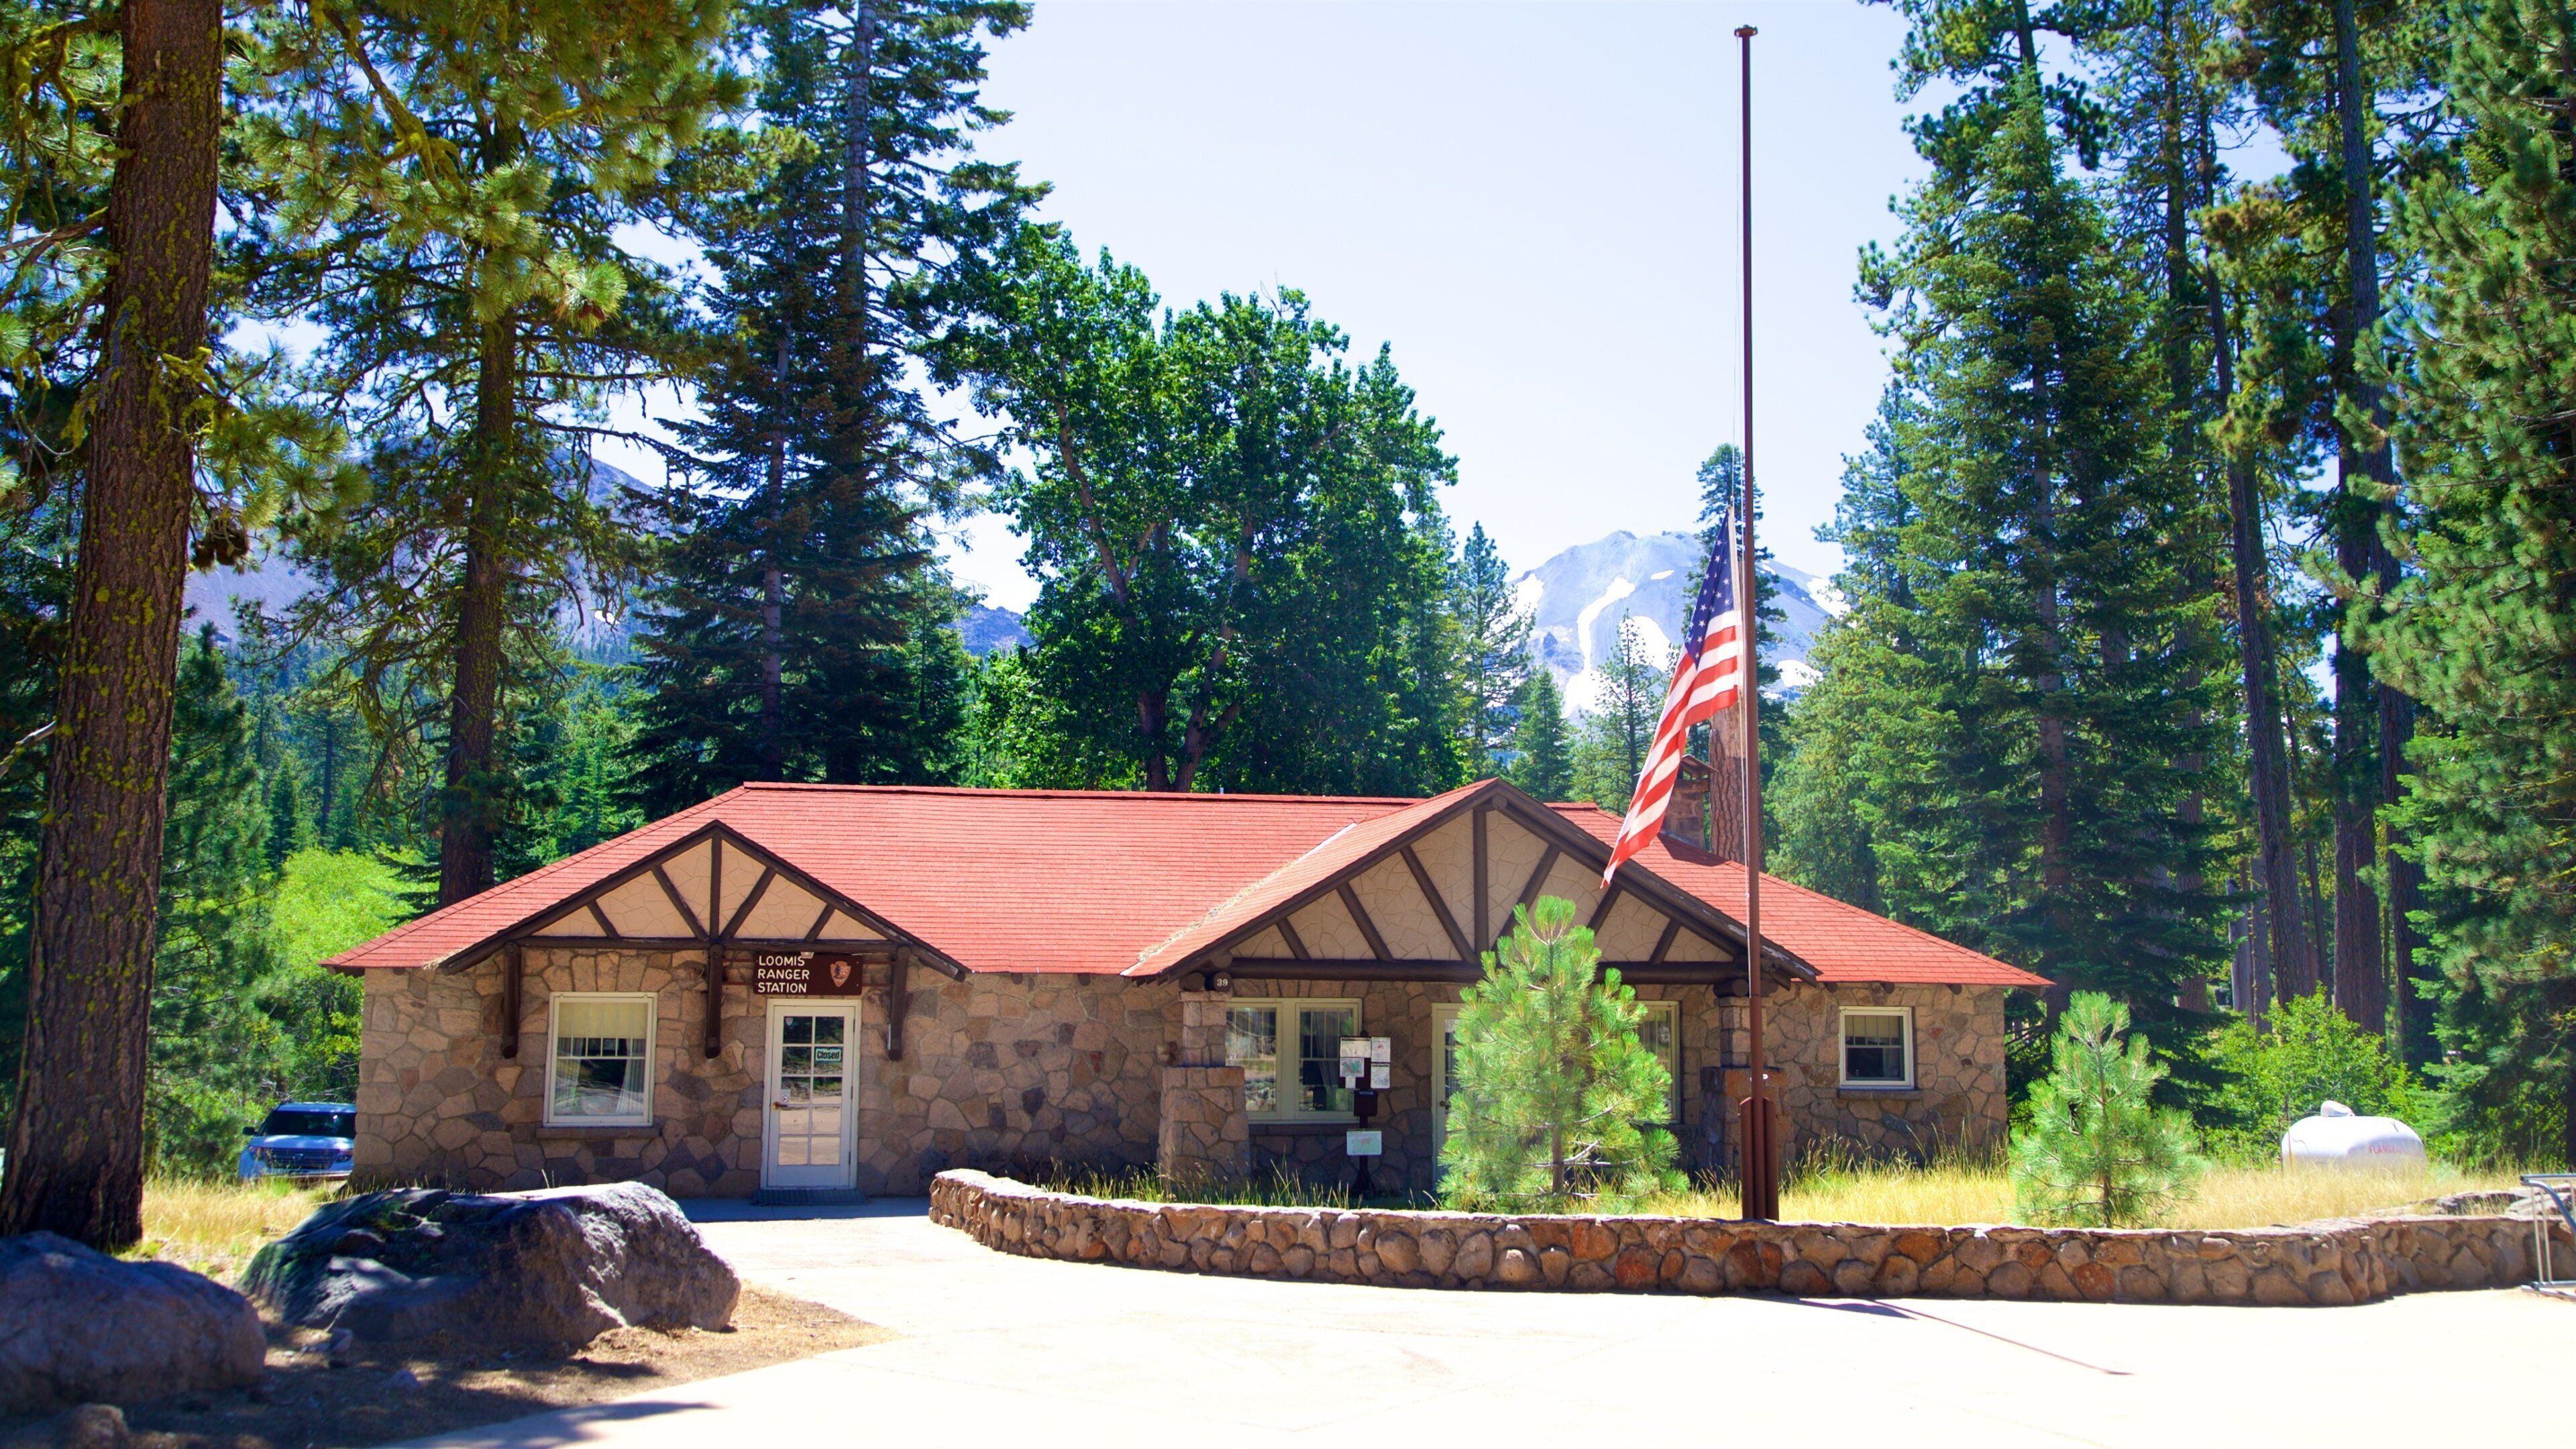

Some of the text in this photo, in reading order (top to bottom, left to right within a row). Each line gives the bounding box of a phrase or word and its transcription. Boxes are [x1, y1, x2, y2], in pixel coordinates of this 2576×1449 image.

[759, 955, 805, 966] LOOMIS
[758, 969, 810, 979] RANGER
[758, 982, 807, 993] STATION
[817, 1051, 840, 1059] Closed
